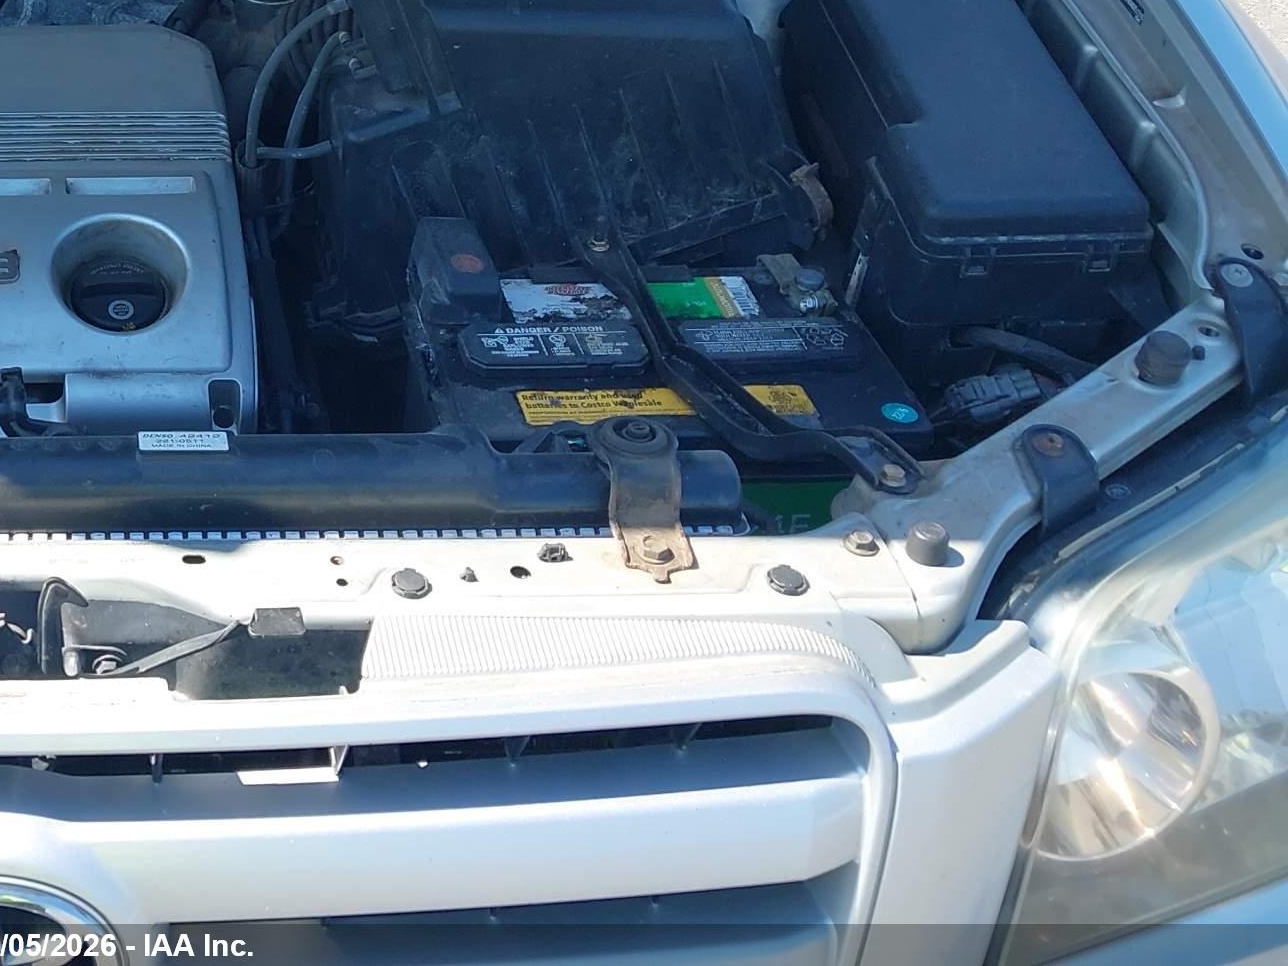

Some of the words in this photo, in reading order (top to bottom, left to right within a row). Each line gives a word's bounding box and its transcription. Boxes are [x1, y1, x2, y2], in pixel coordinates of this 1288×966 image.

[505, 326, 552, 334] DANGER
[562, 325, 603, 333] POISON
[556, 394, 598, 402] warranty
[600, 390, 619, 400] and
[580, 401, 612, 409] Costco
